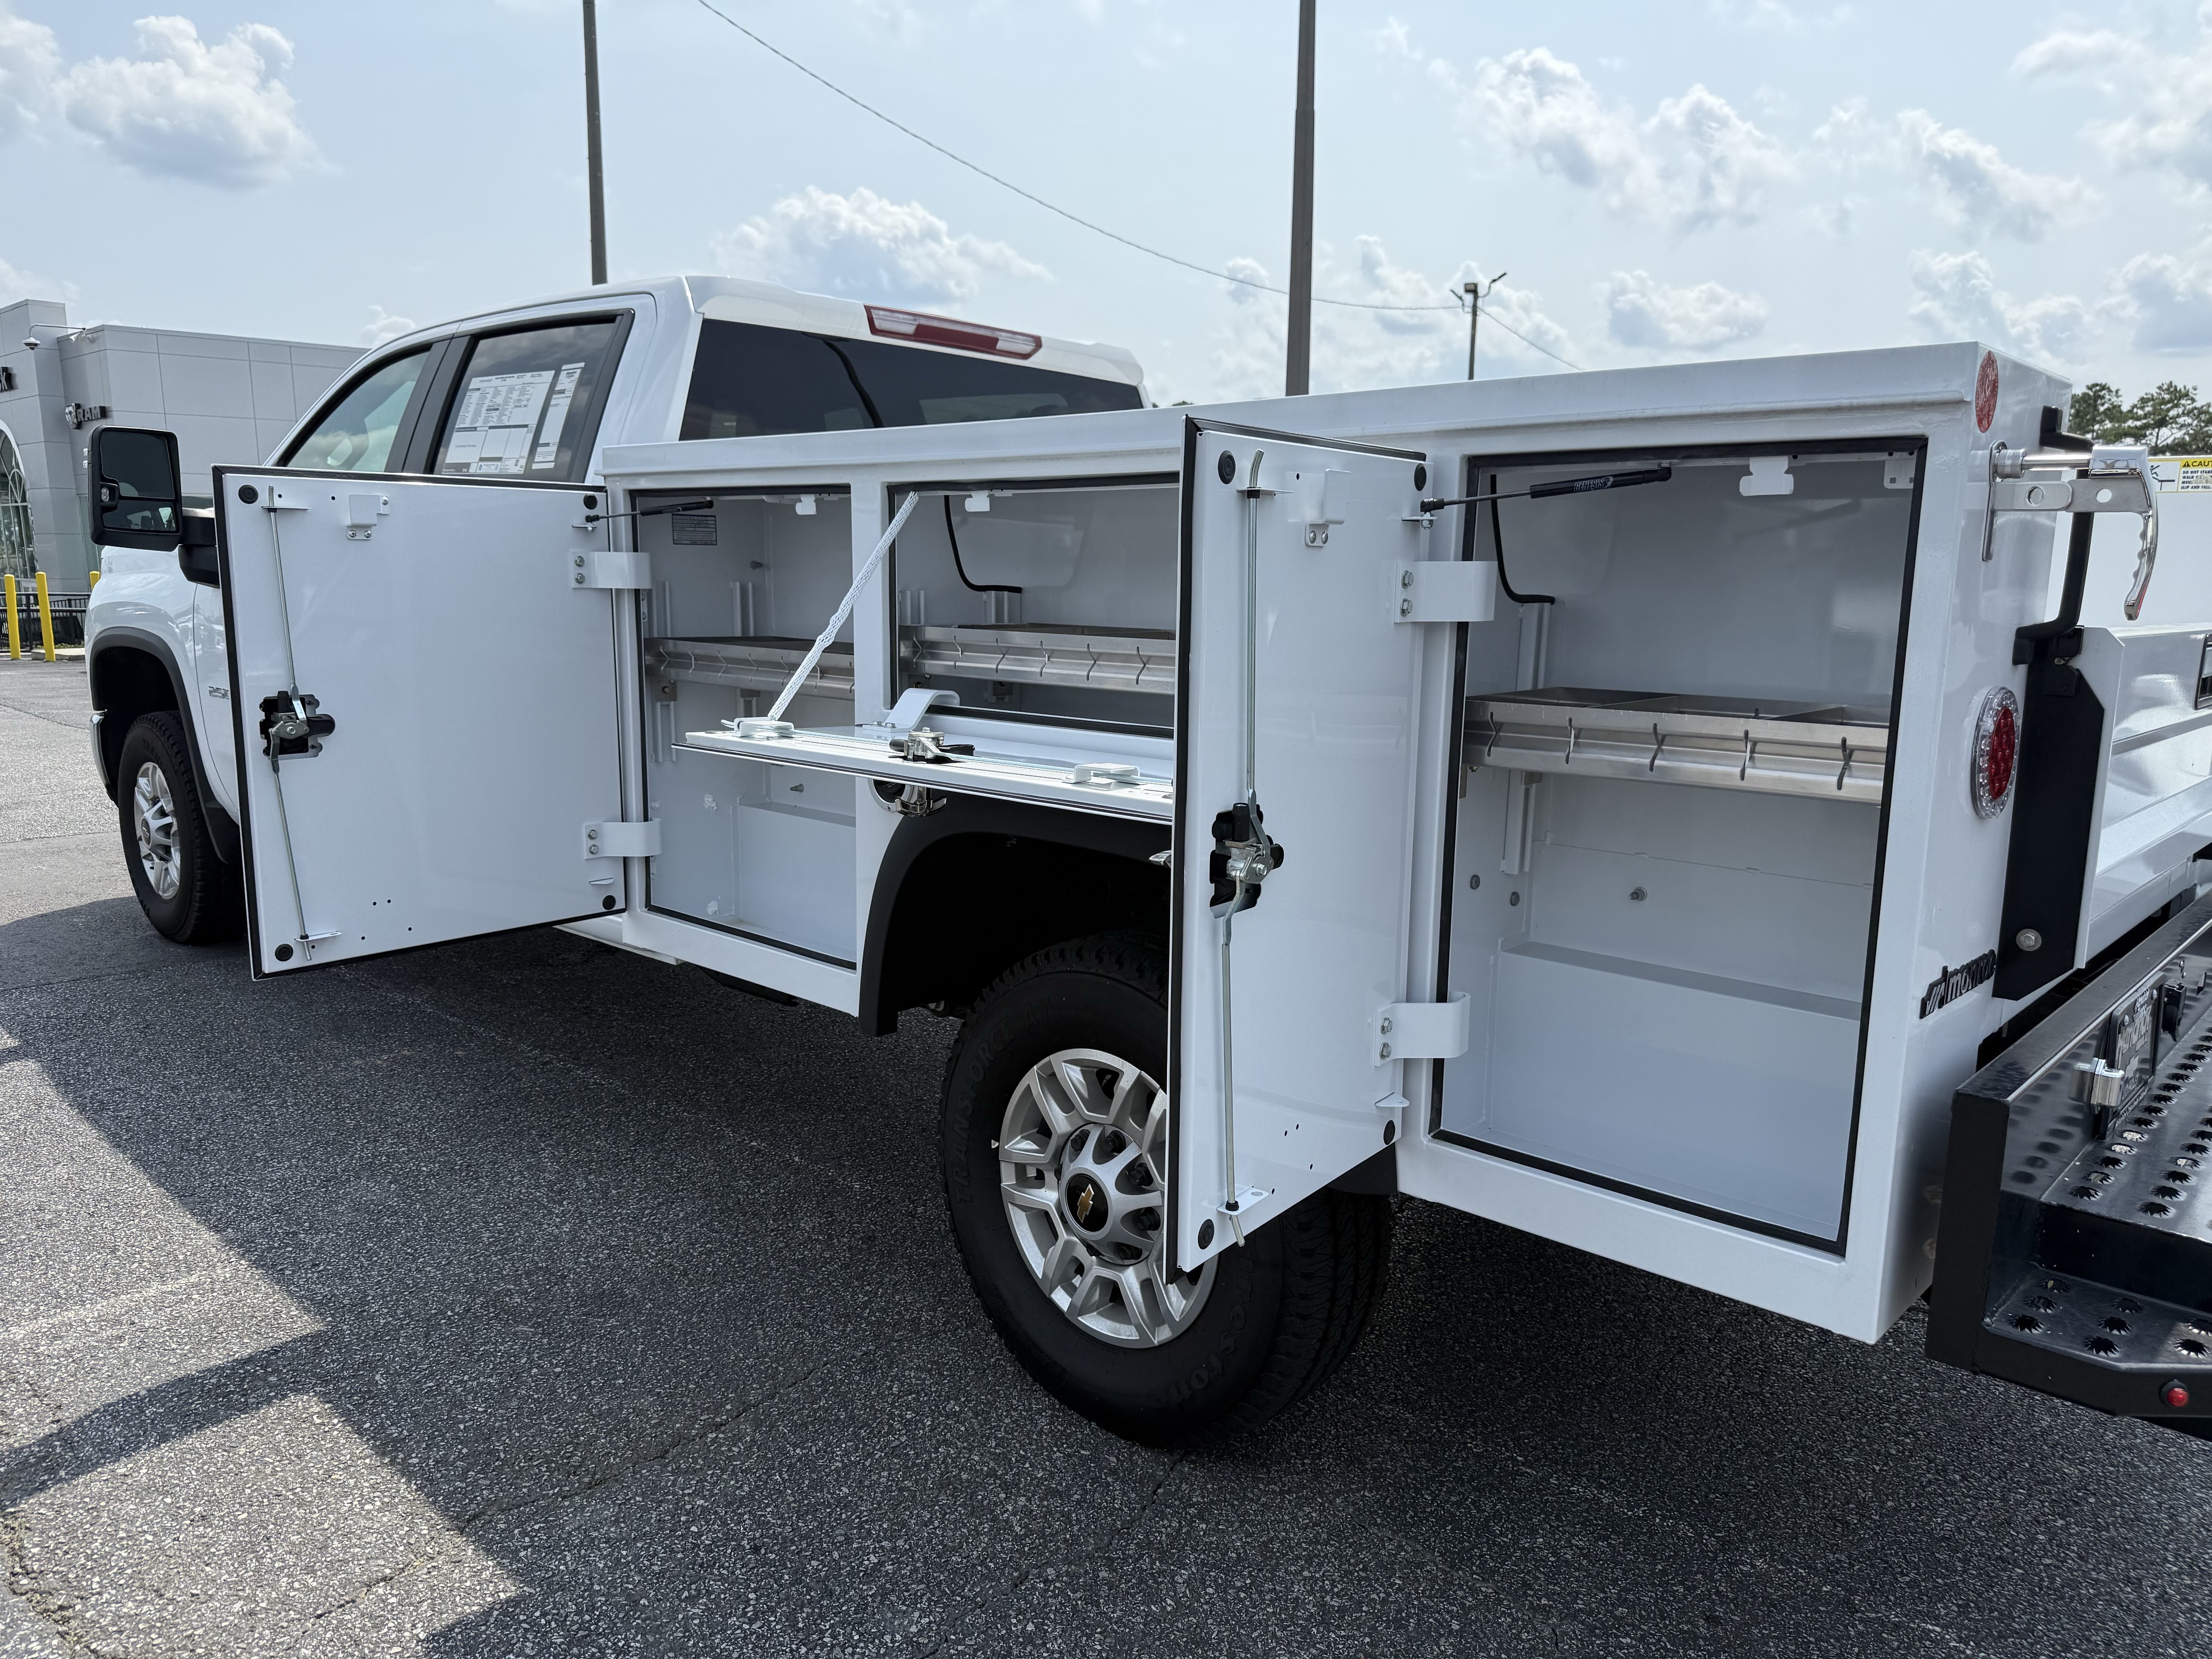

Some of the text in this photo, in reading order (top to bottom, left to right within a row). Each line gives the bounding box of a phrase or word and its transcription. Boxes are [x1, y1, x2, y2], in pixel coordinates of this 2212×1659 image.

[76, 405, 101, 422] RAM
[1574, 479, 1604, 491] GENESIS
[953, 1015, 1016, 1204] TRANSFORCE
